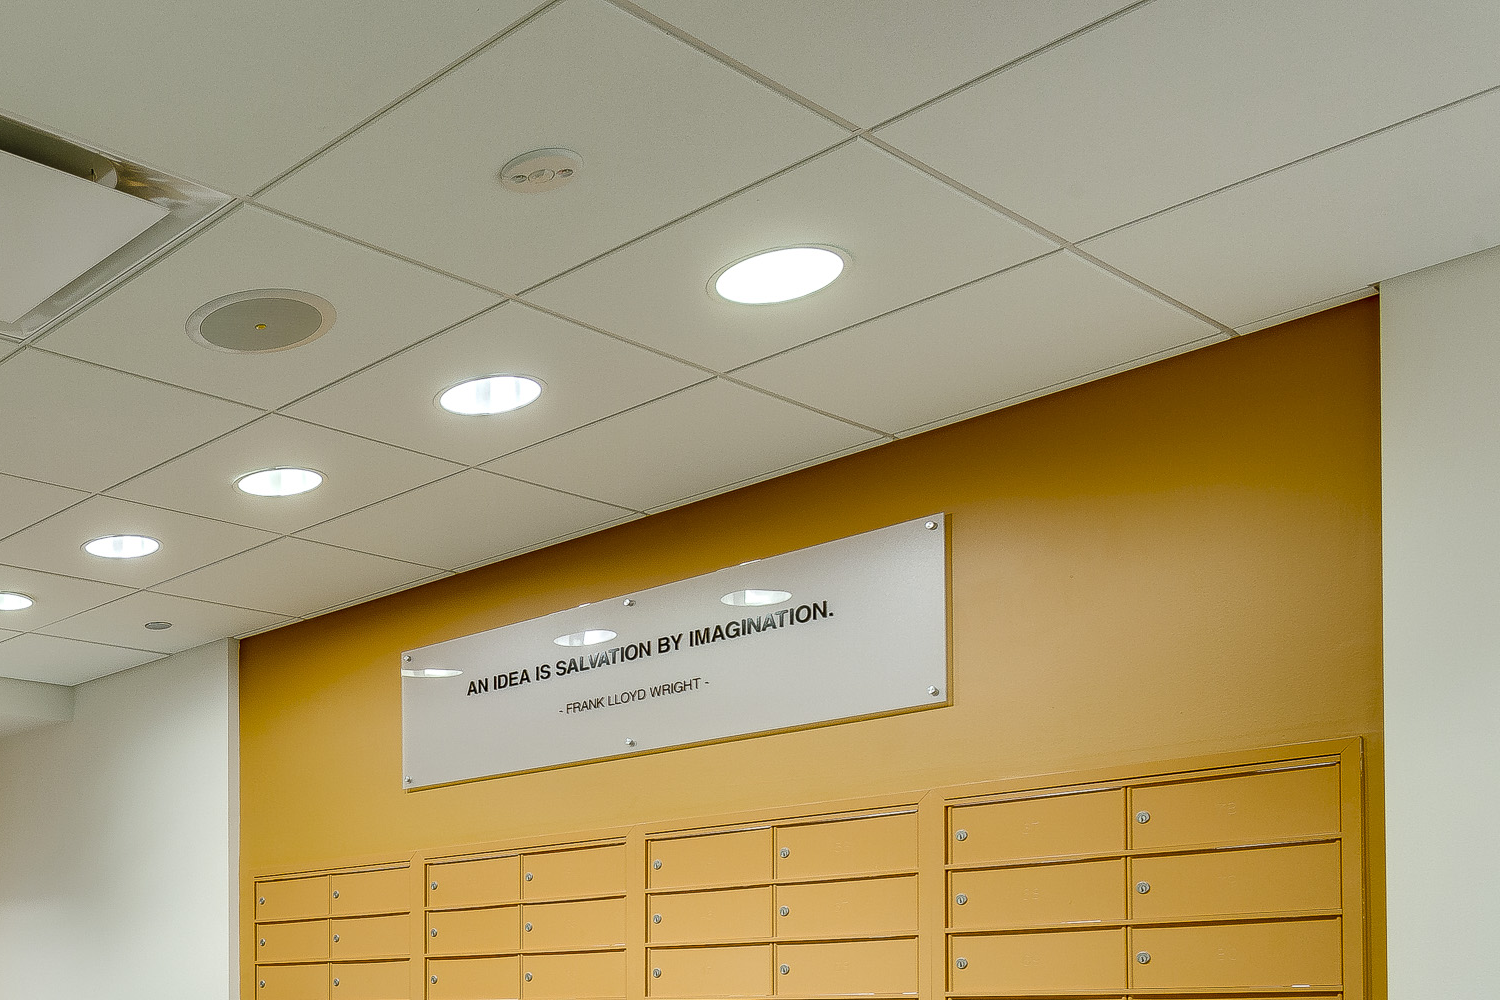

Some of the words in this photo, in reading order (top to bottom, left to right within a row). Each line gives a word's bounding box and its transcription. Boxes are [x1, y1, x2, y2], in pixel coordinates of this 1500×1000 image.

[467, 678, 489, 696] AN
[493, 669, 531, 690] IDEA
[535, 664, 551, 681] IS
[556, 640, 651, 676] SALVATION
[658, 633, 683, 654] BY
[689, 600, 834, 647] IMAGINATION.
[566, 696, 605, 714] FRANK
[607, 689, 646, 706] LLOYD
[650, 677, 701, 698] WRIGHT
